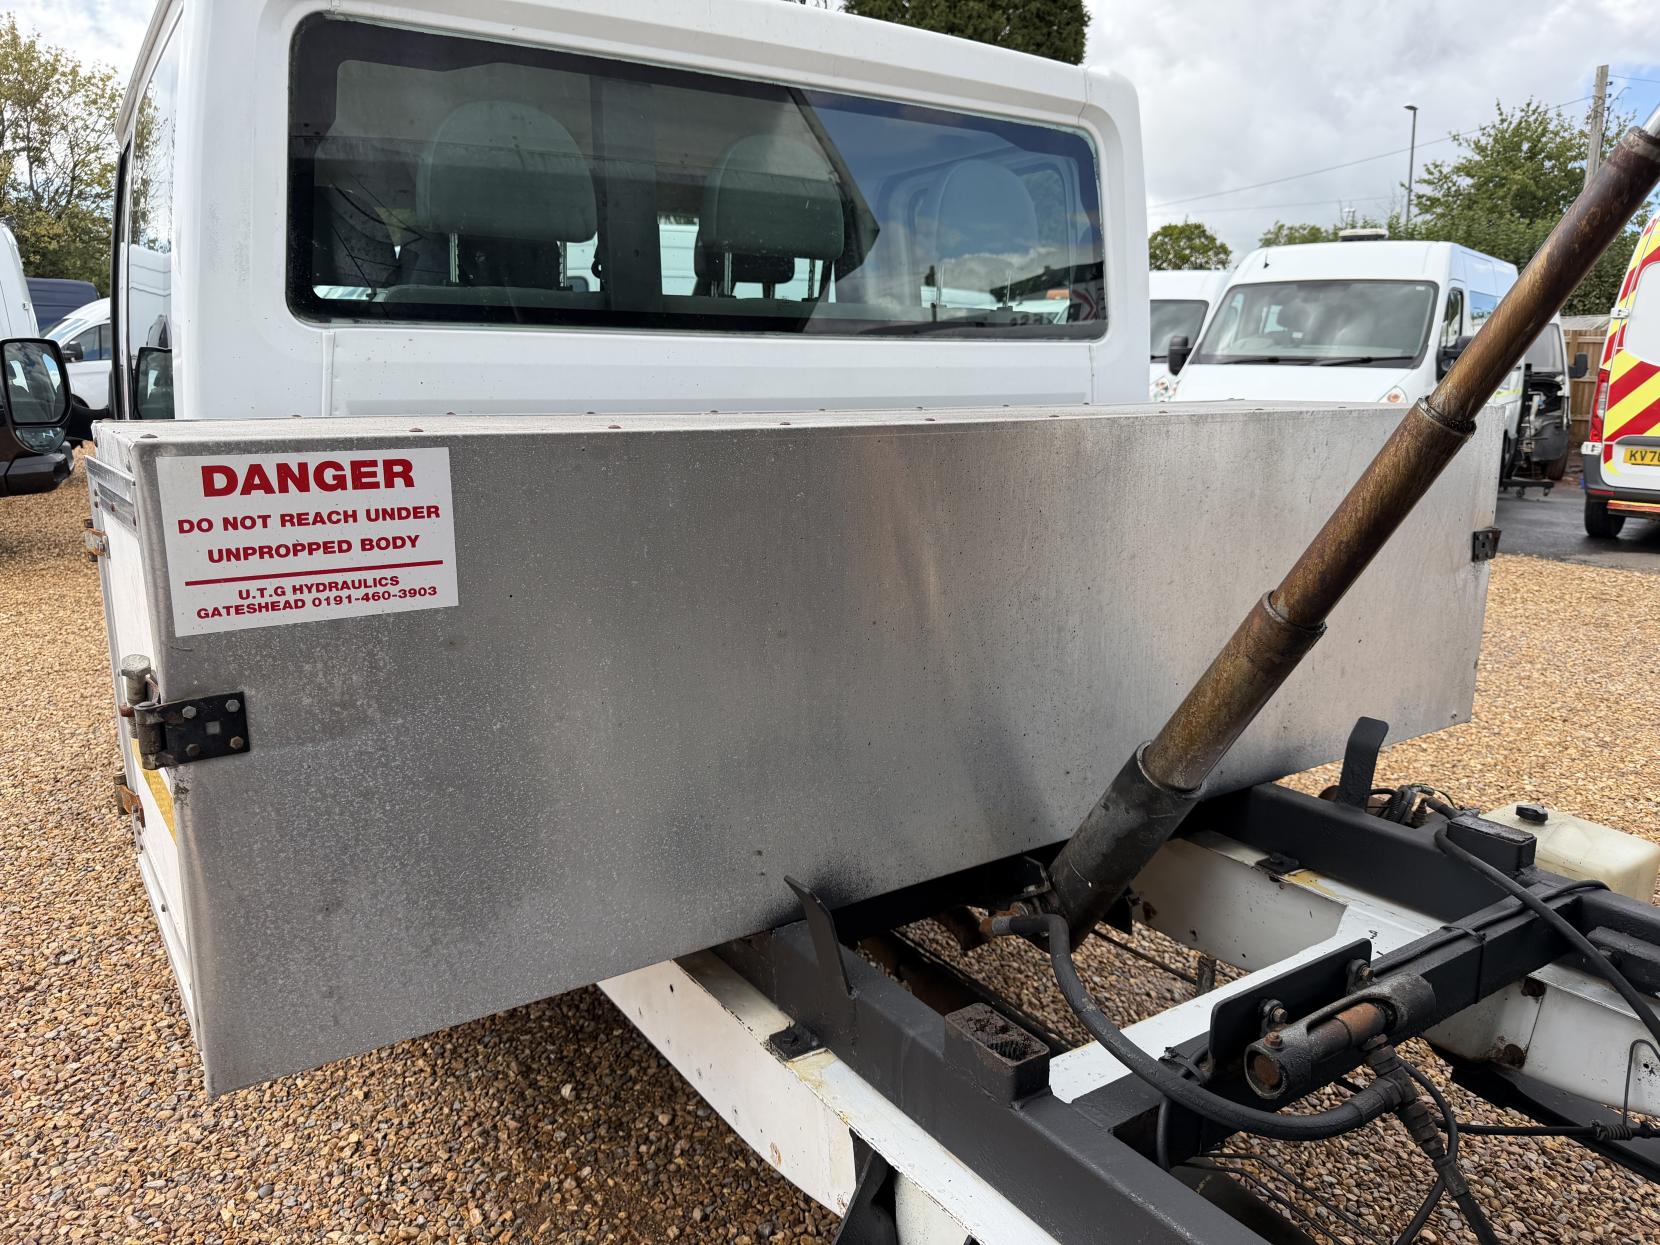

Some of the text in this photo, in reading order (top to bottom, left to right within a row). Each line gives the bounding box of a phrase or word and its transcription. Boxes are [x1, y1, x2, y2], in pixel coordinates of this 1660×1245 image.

[201, 459, 415, 497] DANGER
[177, 505, 441, 534] DO NOT REACH UNDER
[207, 535, 421, 563] UNPROPPED BODY
[238, 576, 400, 601] U.T.G HYDRAULICS
[196, 587, 437, 620] GATESHEAD 0191-460-3903
